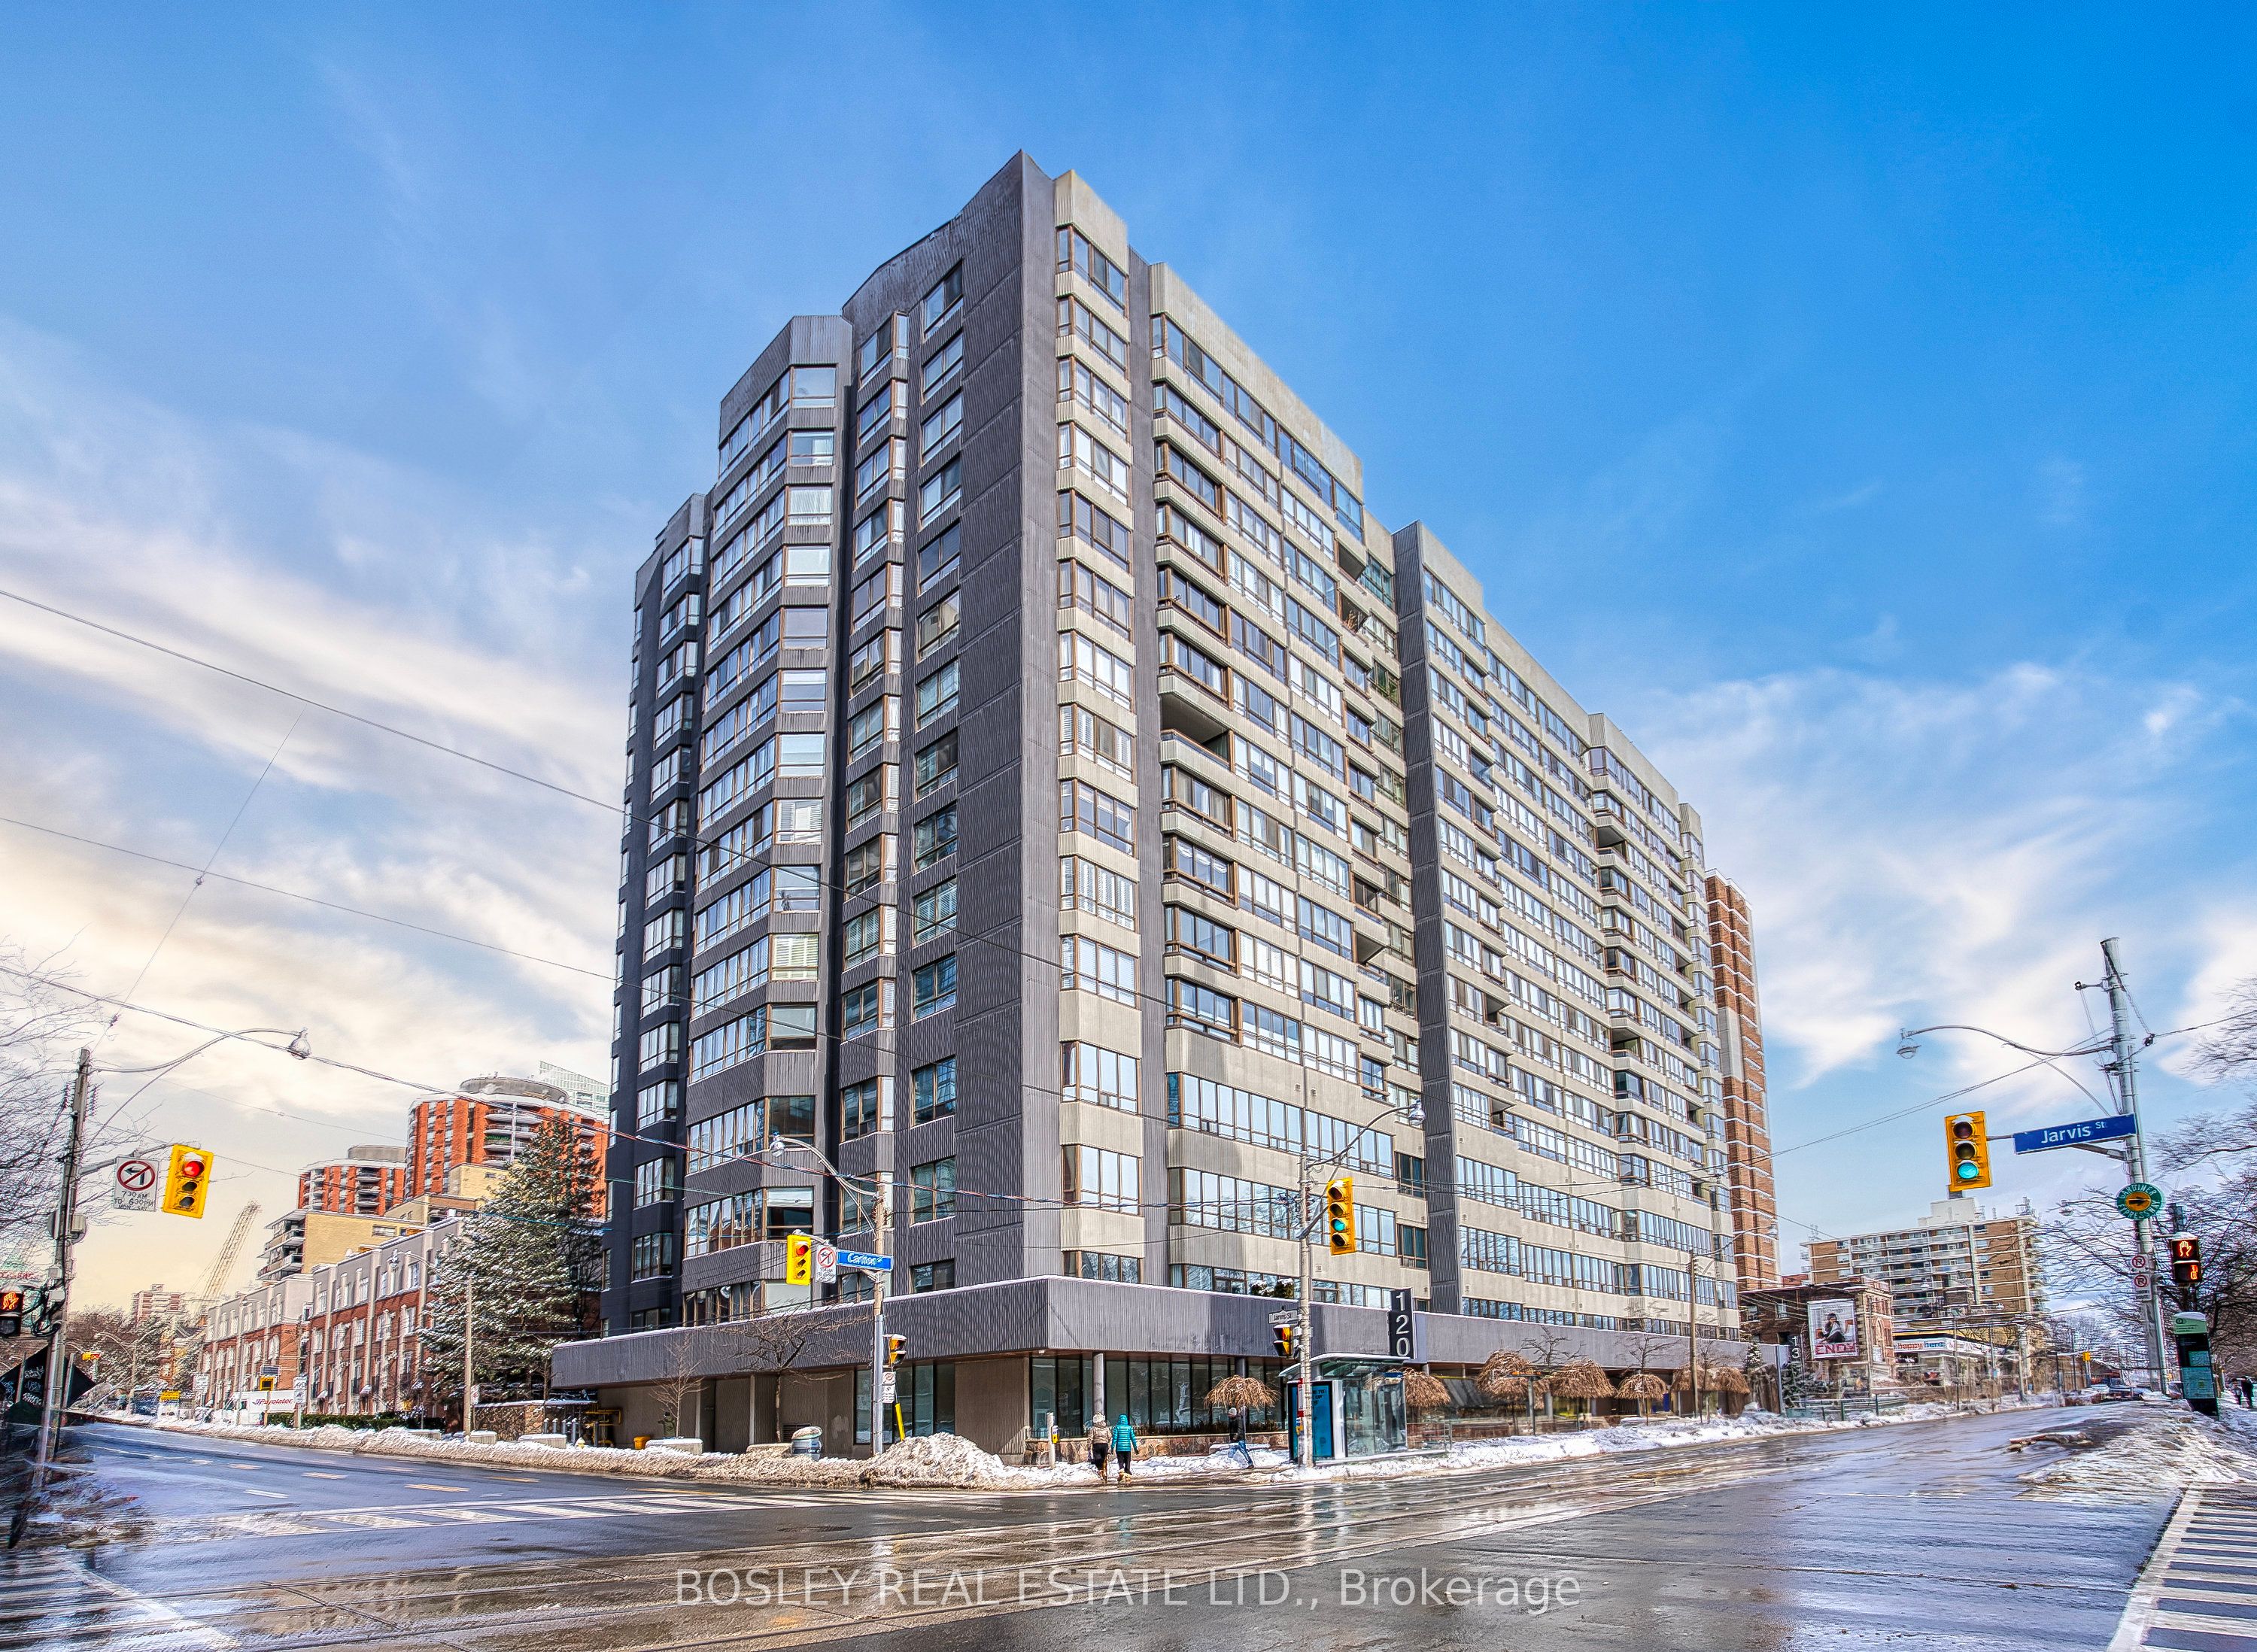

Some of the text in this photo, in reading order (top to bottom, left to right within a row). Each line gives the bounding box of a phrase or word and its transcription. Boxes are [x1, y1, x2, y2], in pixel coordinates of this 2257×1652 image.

[2041, 1121, 2106, 1143] Jarvis St
[2119, 1184, 2157, 1199] GARDINER
[1396, 1292, 1410, 1356] 120
